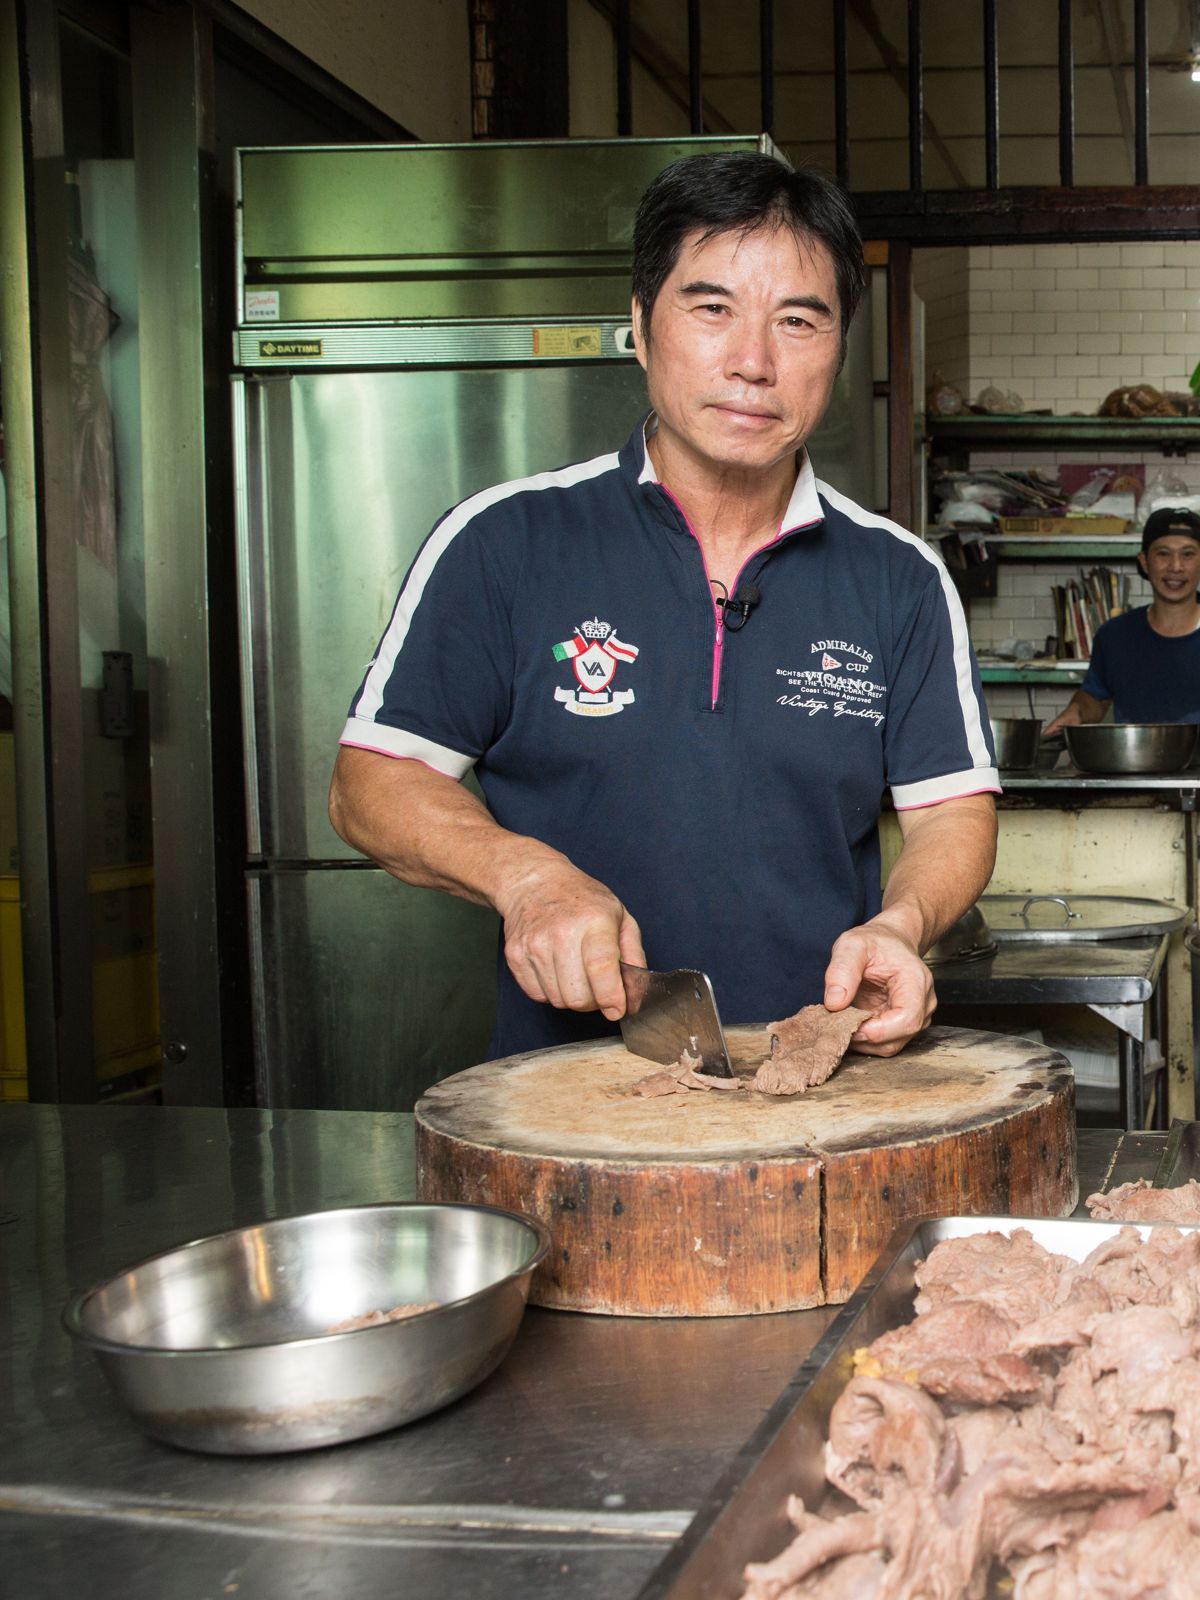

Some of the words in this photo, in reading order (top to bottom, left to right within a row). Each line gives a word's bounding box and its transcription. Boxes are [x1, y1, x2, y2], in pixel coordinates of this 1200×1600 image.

[277, 344, 320, 353] DAYTIME
[846, 663, 869, 673] CUP
[776, 695, 829, 716] Vintage
[834, 701, 885, 726] Yachting
